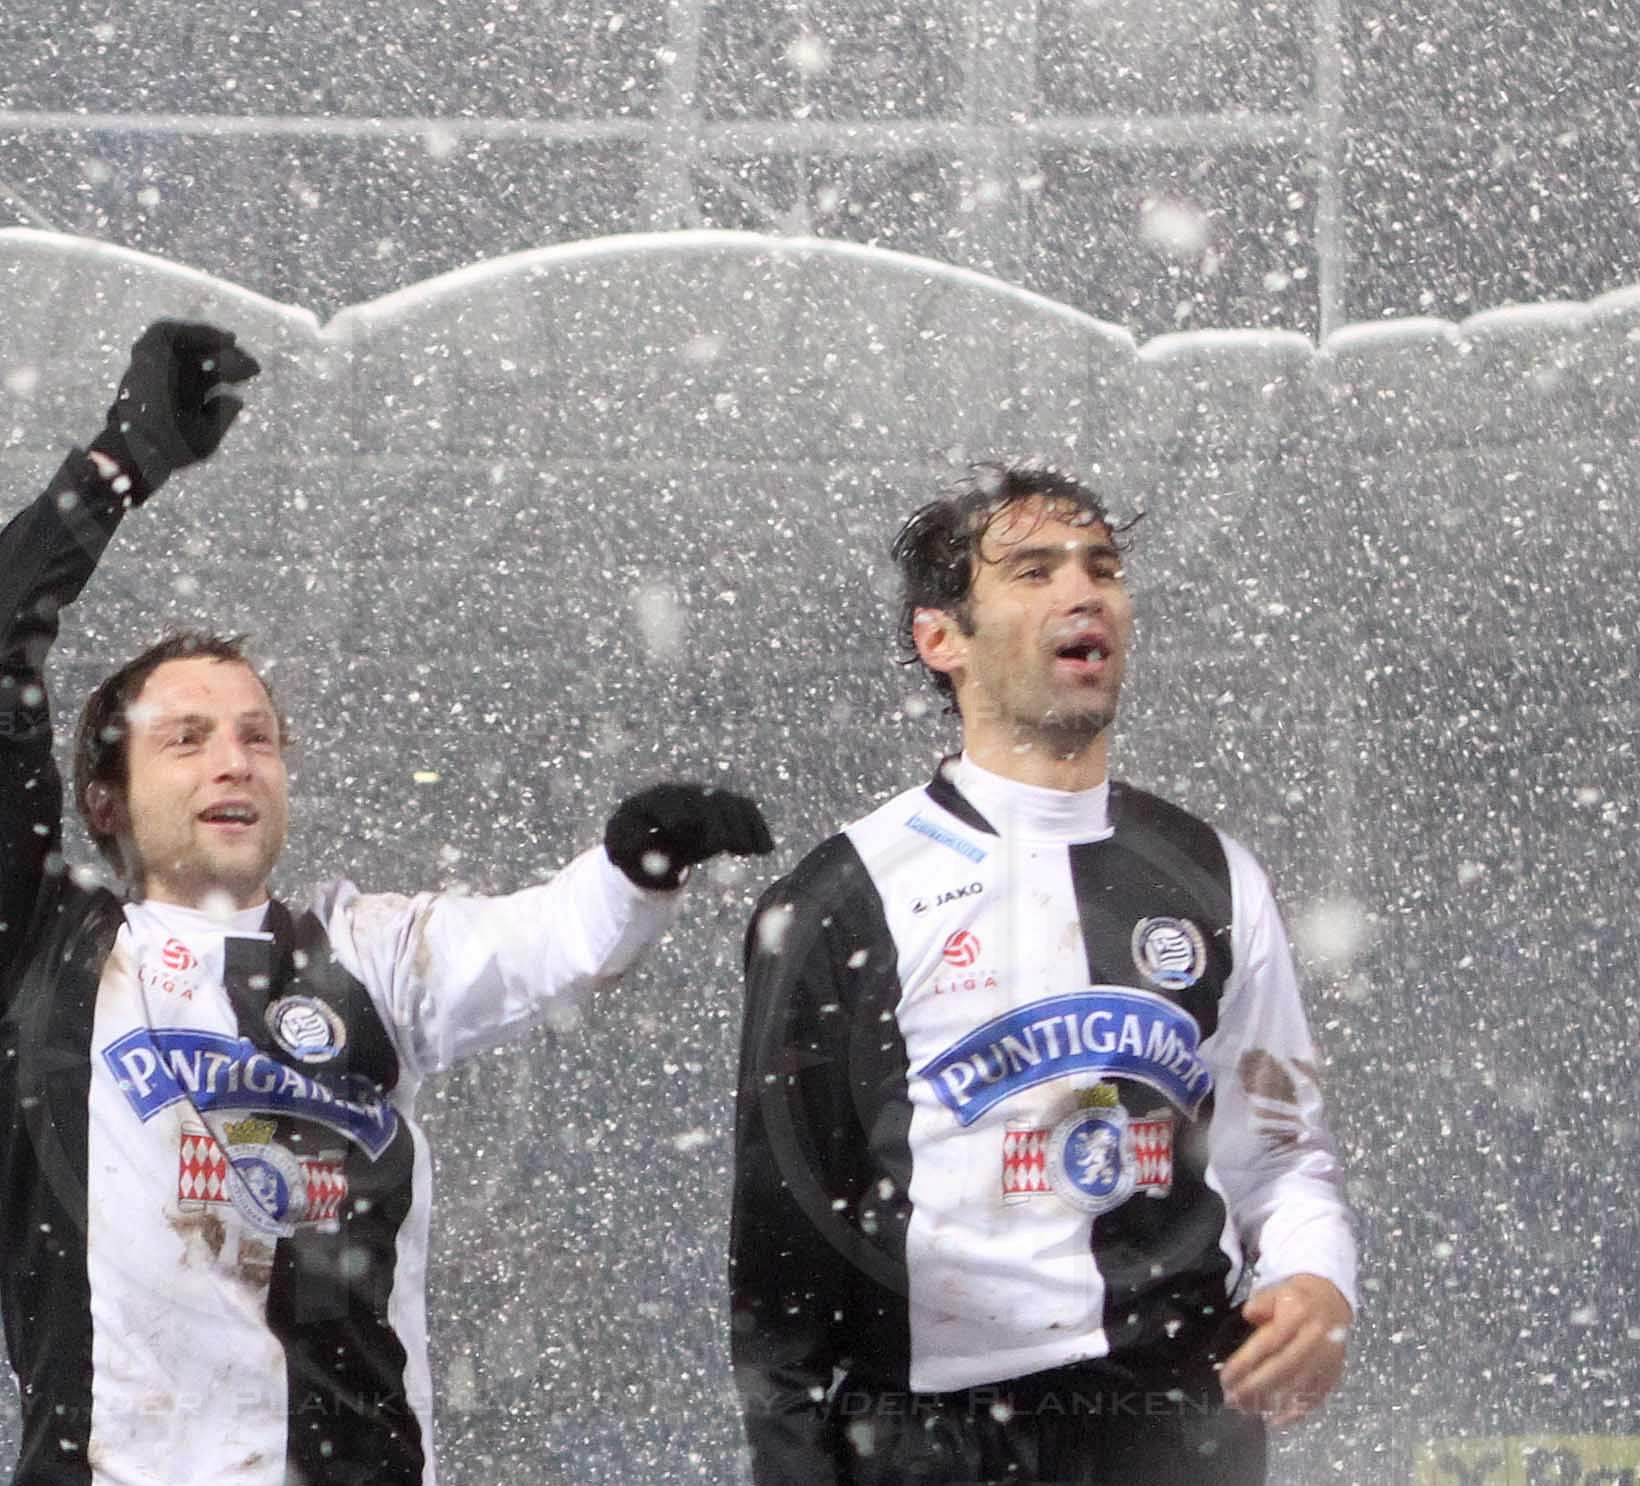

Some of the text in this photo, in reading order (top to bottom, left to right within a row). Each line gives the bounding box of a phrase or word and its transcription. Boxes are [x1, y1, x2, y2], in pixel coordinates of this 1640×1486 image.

[937, 882, 983, 906] JAKO
[935, 977, 998, 995] LIGA
[940, 1011, 1206, 1106] PUNTIGAMER
